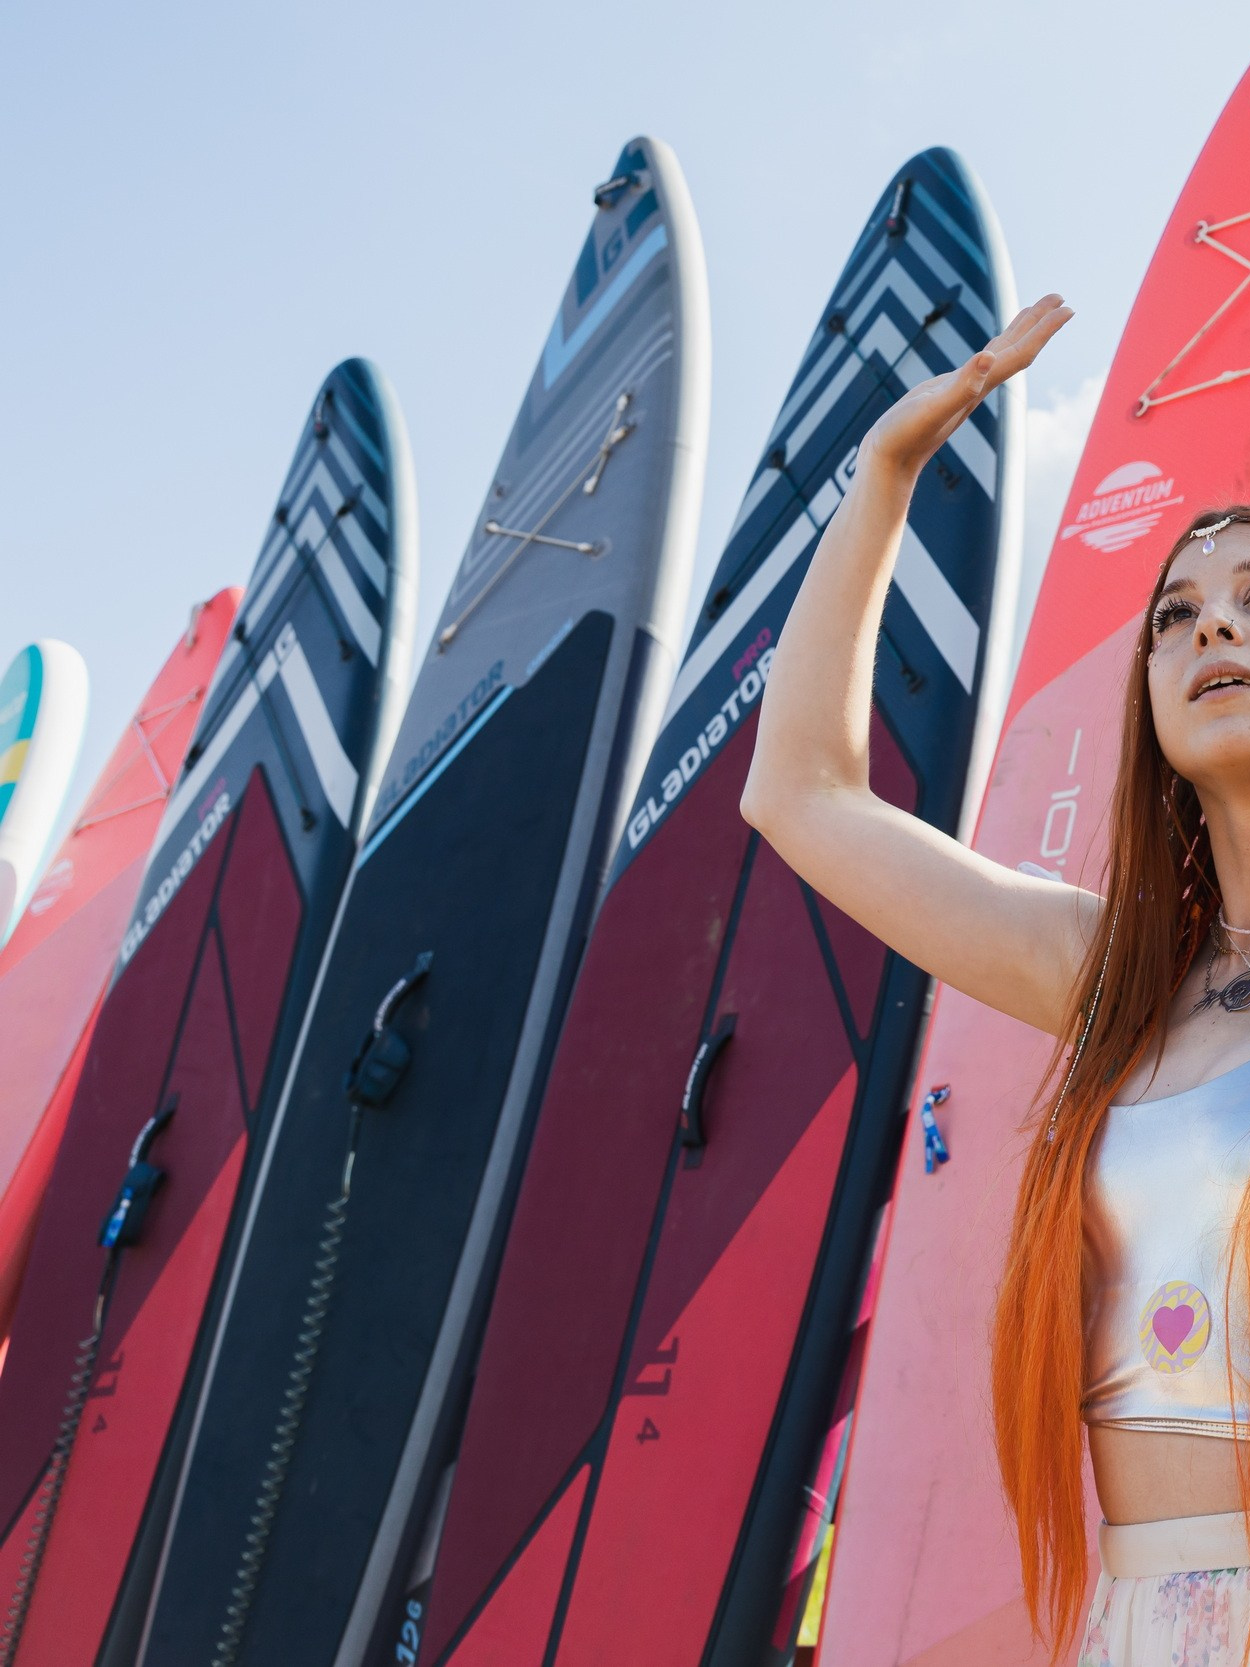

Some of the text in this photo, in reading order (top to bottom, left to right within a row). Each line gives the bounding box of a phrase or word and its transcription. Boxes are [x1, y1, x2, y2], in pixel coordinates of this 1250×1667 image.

[1075, 477, 1174, 522] ADVENTUM
[731, 626, 772, 683] PRO
[636, 1417, 661, 1444] 4
